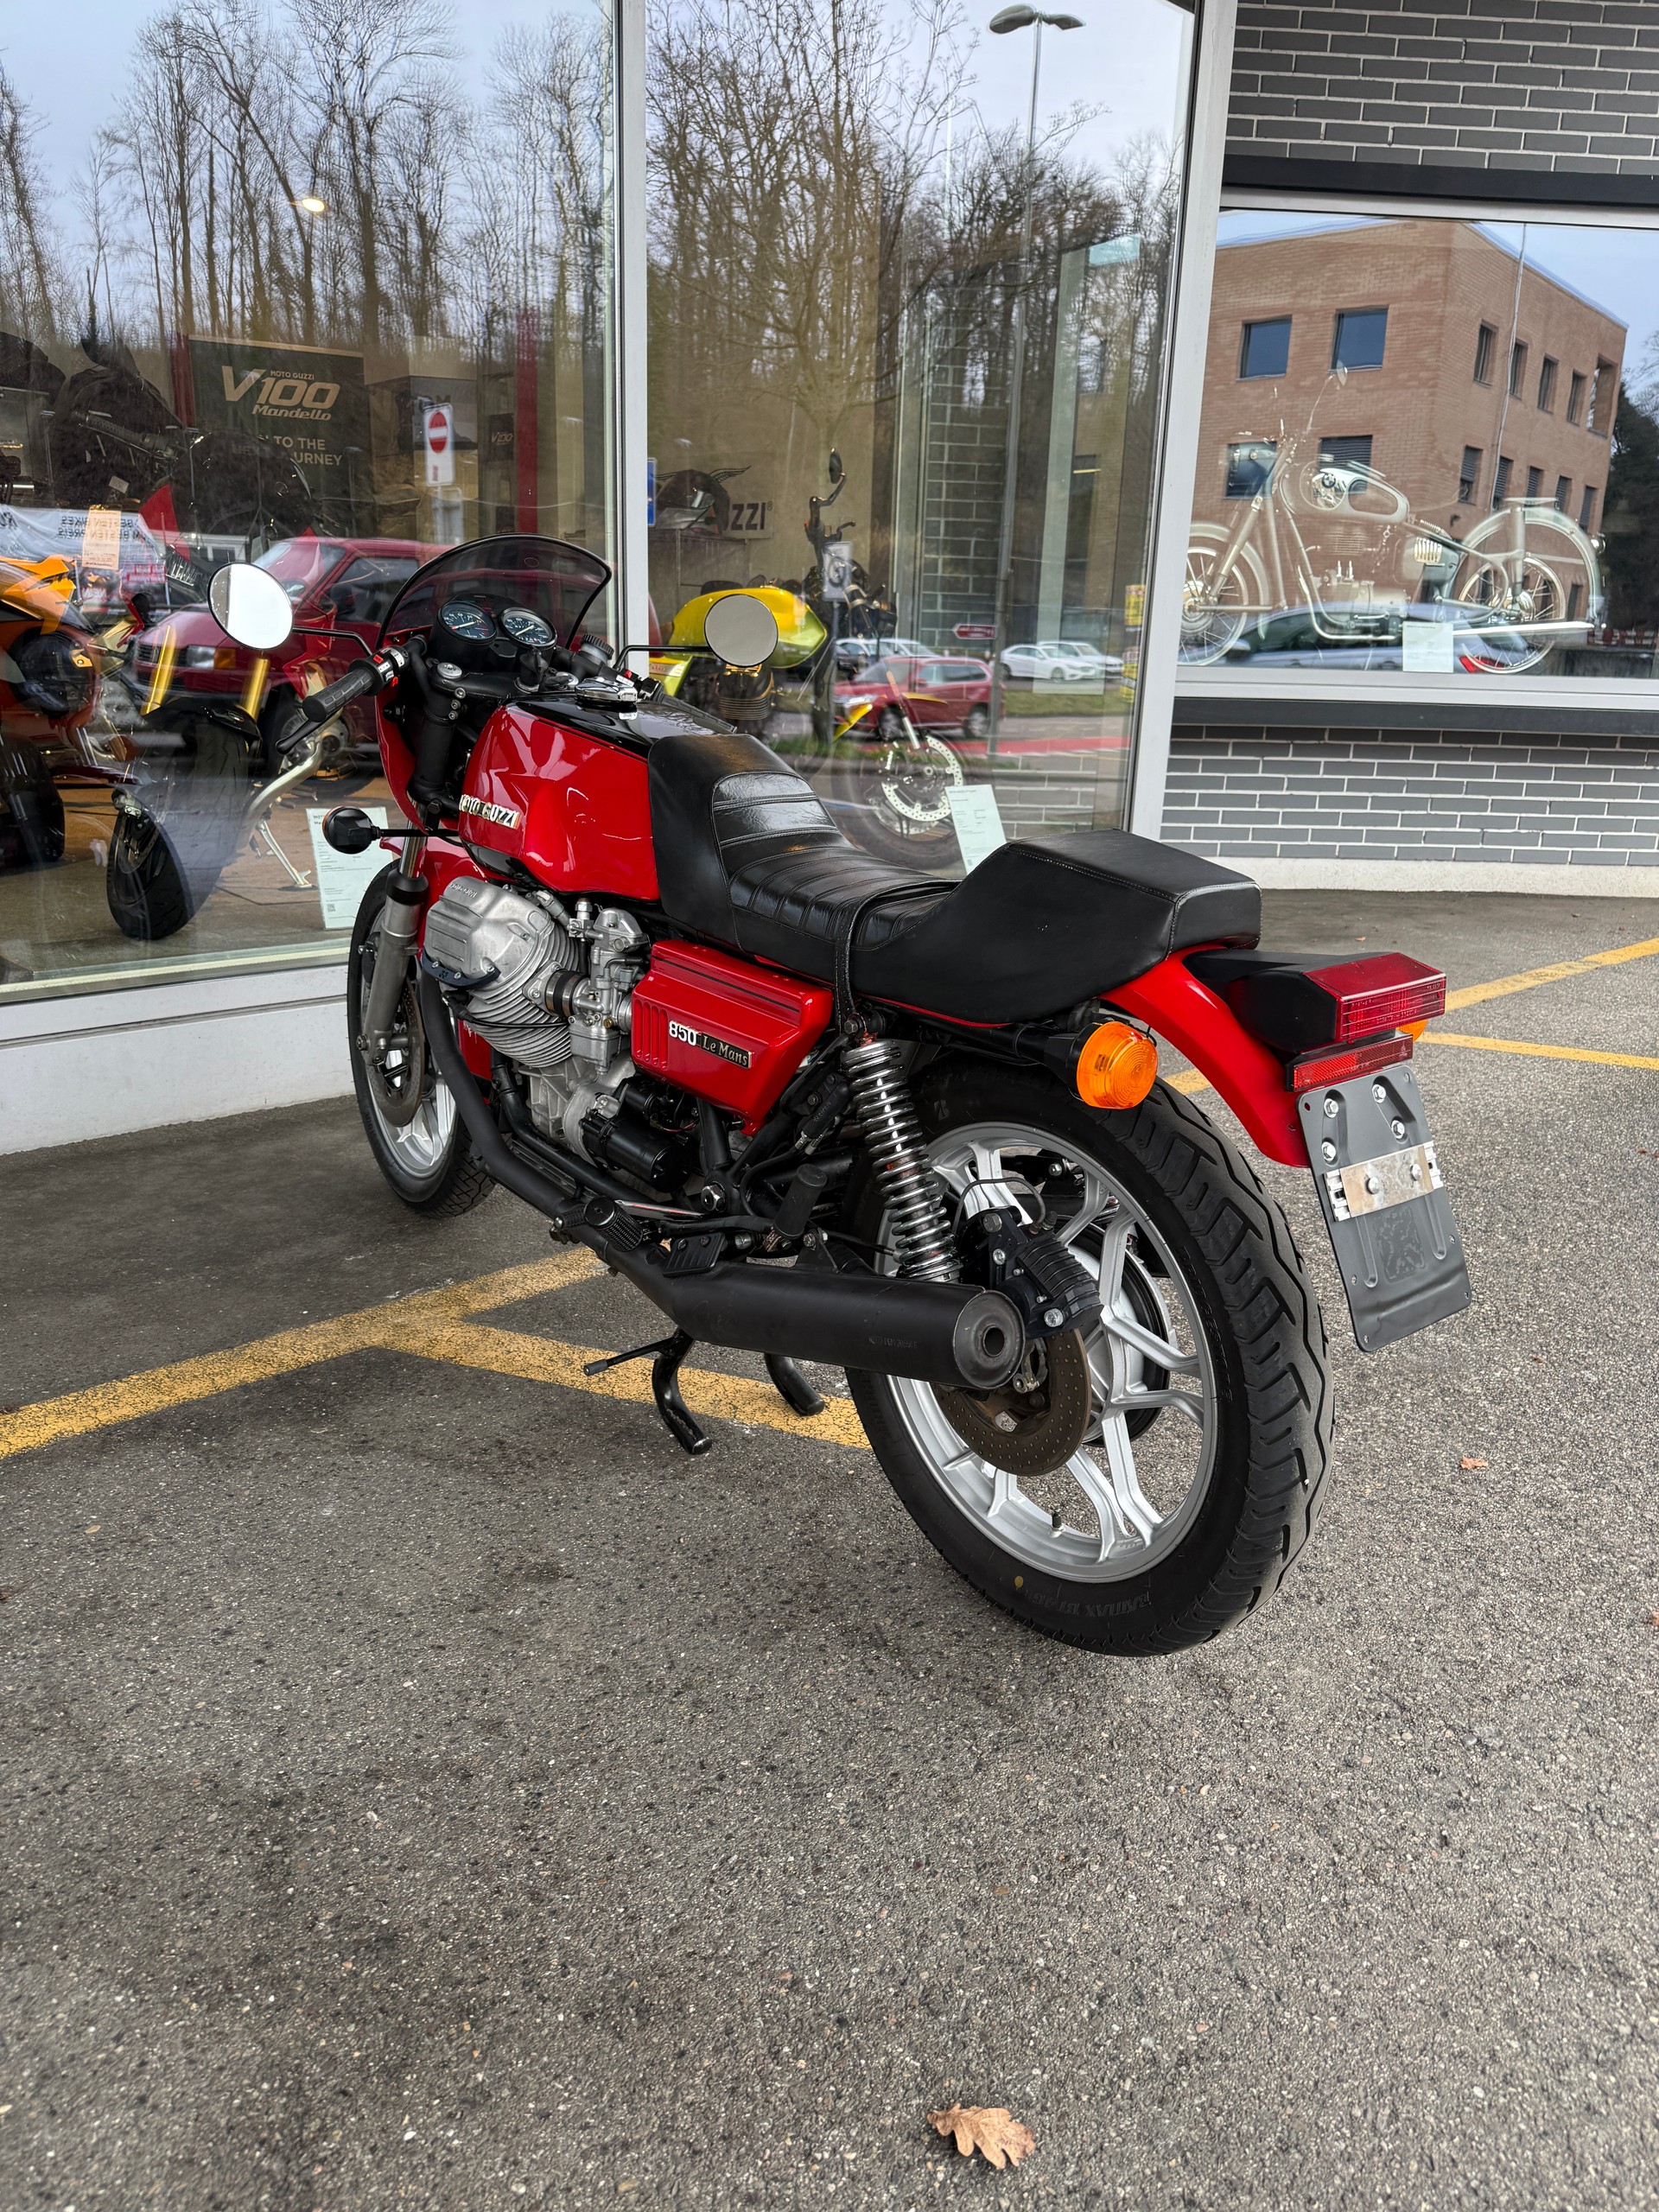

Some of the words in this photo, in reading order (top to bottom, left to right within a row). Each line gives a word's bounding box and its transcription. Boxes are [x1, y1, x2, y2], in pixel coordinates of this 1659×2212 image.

[270, 370, 291, 378] MOTO
[221, 365, 340, 410] V100
[251, 404, 332, 421] Mandello
[274, 435, 294, 448] TO
[297, 437, 326, 450] THE
[294, 452, 342, 467] URNEY
[731, 502, 766, 531] ZZI
[482, 802, 520, 830] GUZZI
[669, 1020, 696, 1046] 850
[702, 1035, 716, 1052] Le
[719, 1041, 748, 1066] Mans
